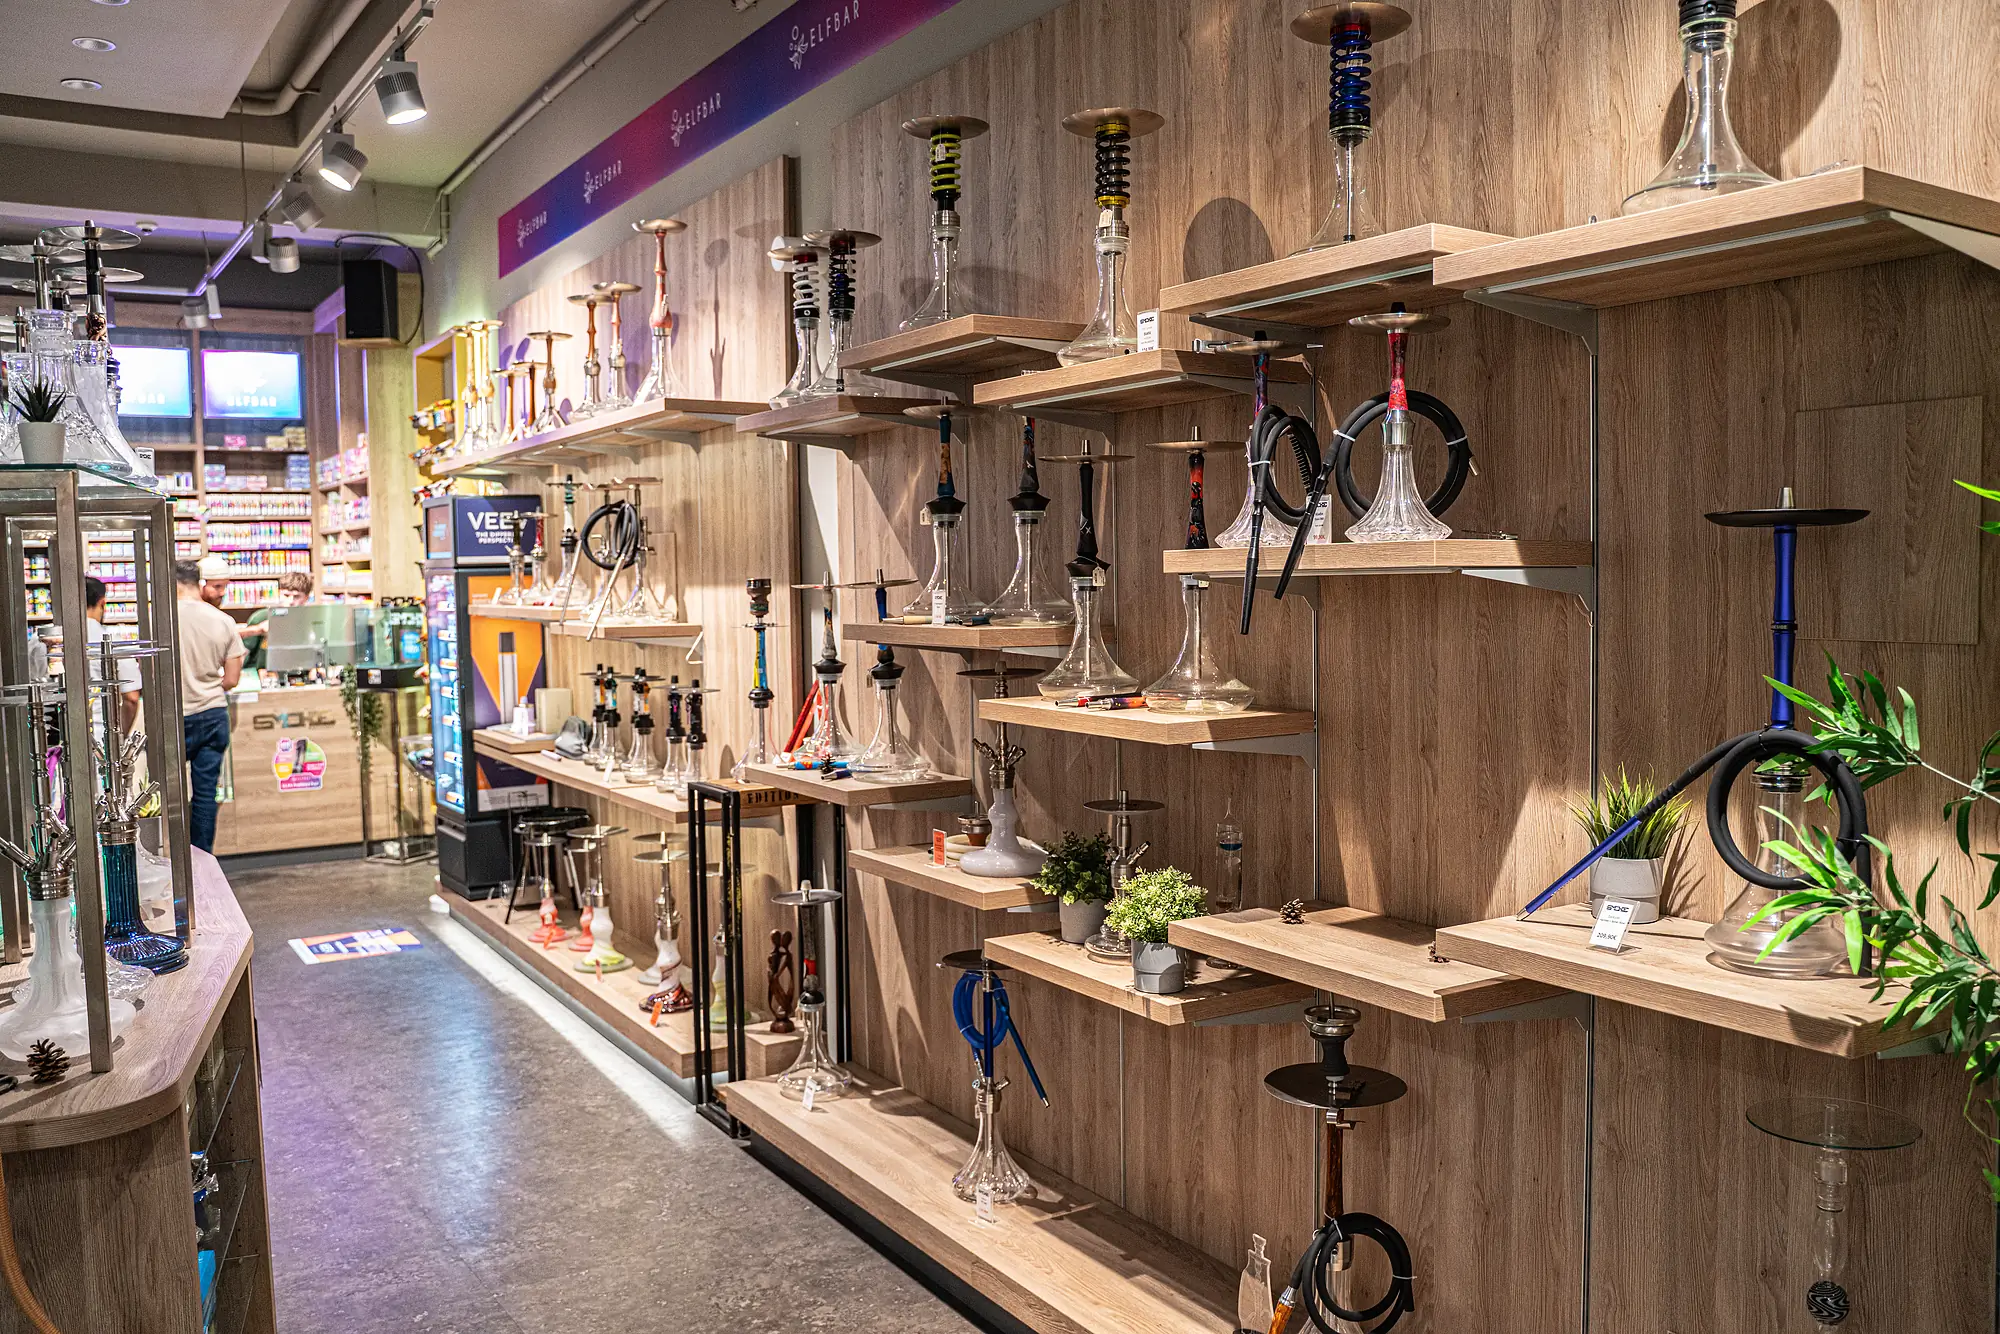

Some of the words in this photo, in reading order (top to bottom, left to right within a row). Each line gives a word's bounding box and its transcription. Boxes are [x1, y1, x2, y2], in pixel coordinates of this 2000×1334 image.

[810, 0, 859, 48] ELFBAR
[685, 92, 721, 131] ELFBAR
[595, 160, 622, 190] ELFBAR
[525, 210, 547, 236] ELFBAR
